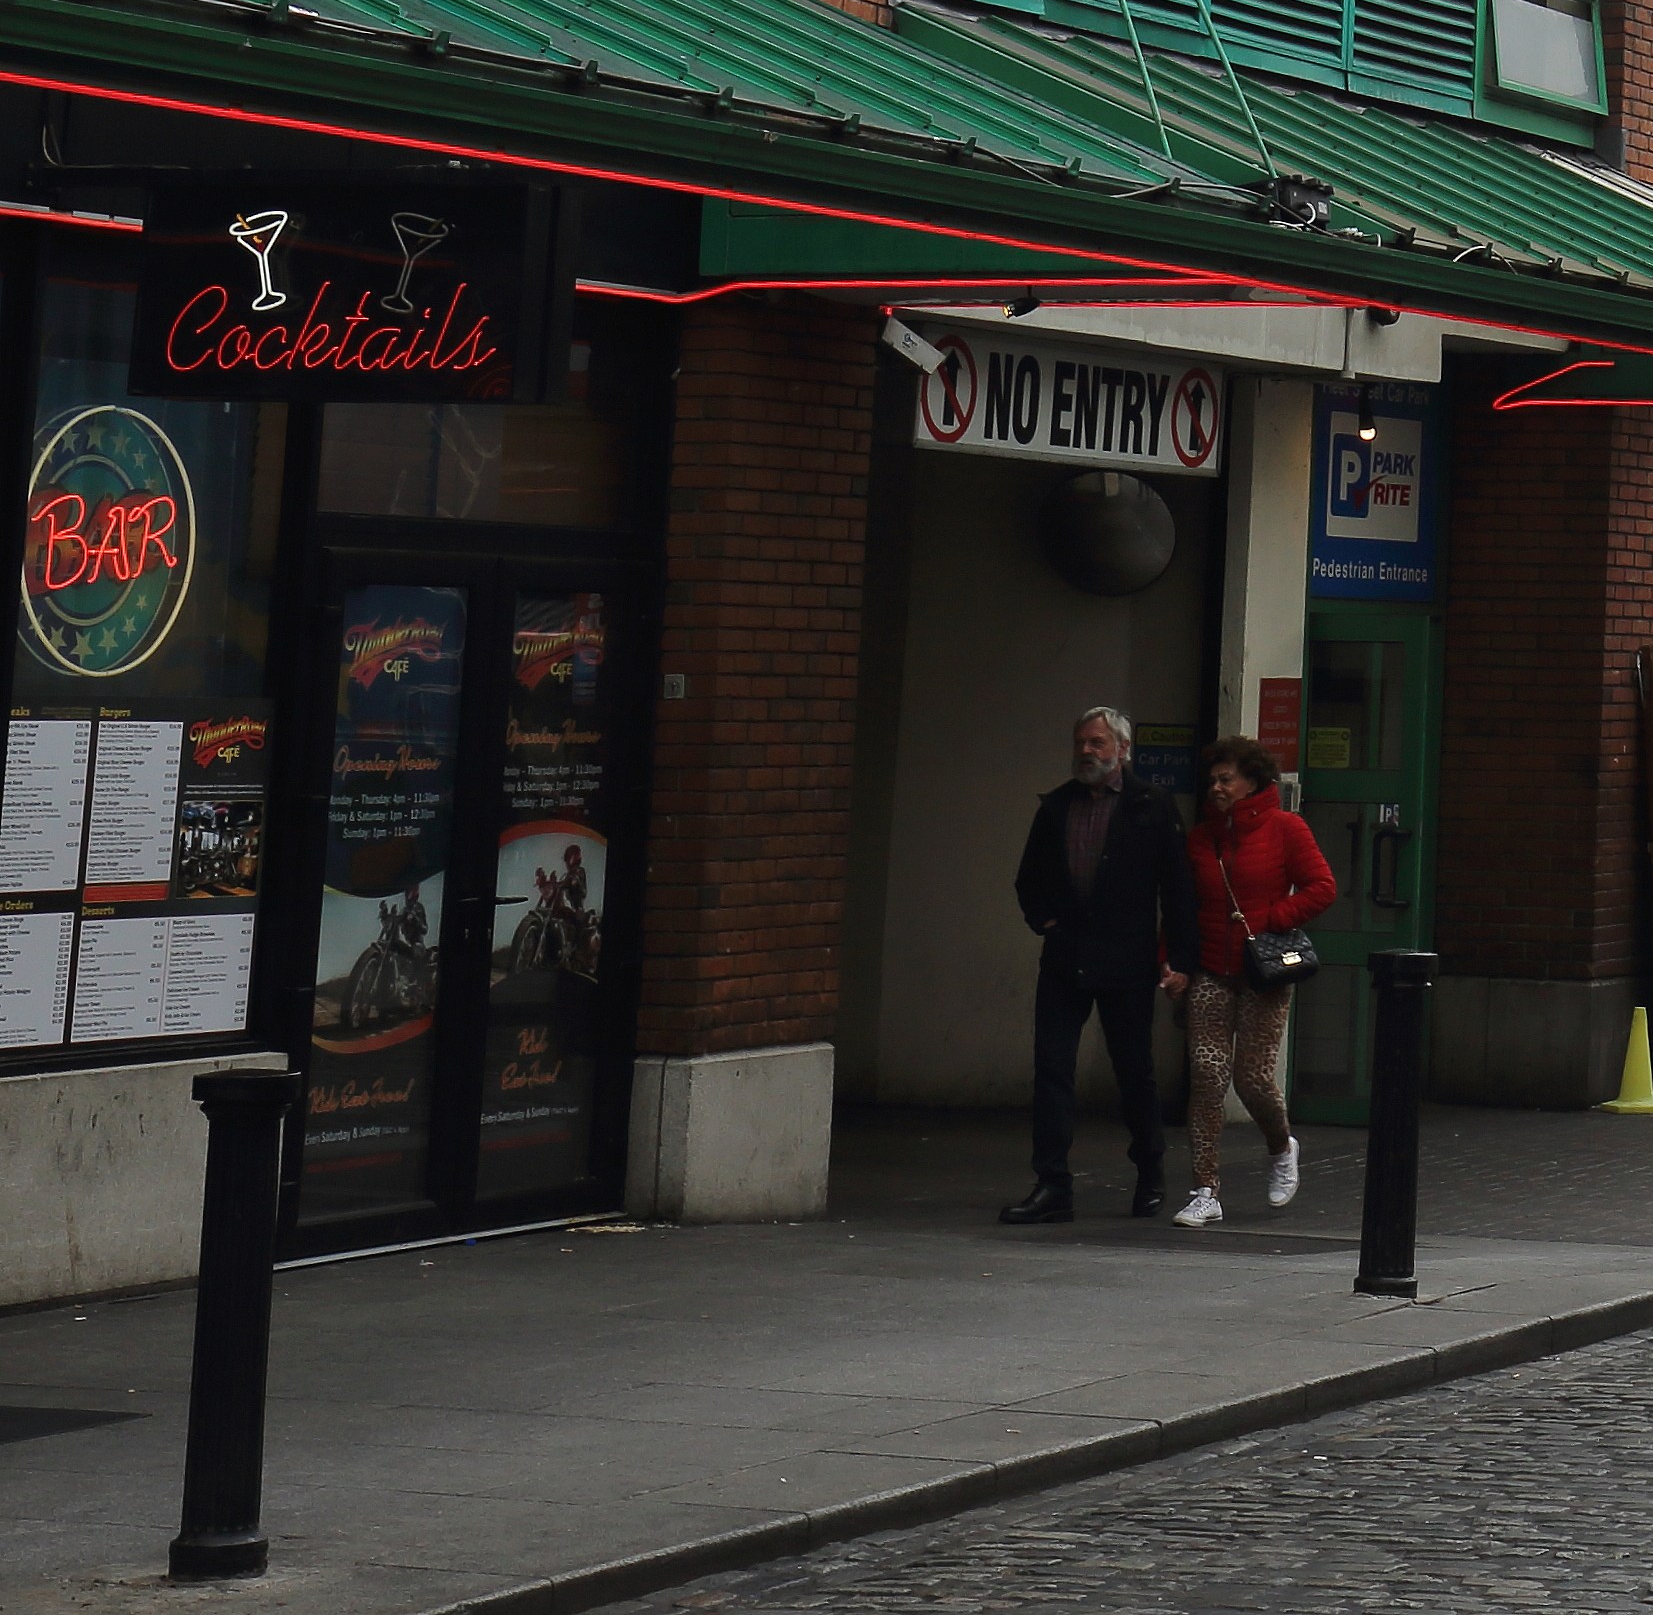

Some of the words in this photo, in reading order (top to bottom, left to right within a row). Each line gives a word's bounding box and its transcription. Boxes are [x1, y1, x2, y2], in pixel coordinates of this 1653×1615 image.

[167, 281, 496, 371] Cocktails
[983, 351, 1041, 445] NO
[1049, 359, 1170, 457] ENTRY
[1352, 385, 1384, 401] Seet
[1339, 450, 1362, 501] P
[1373, 451, 1416, 476] PARK
[1373, 483, 1411, 507] RITE
[31, 495, 177, 589] BAR
[1312, 557, 1375, 579] Pedestrian
[1379, 561, 1428, 583] Entrance
[1138, 752, 1161, 766] Car
[1151, 773, 1176, 786] Exit
